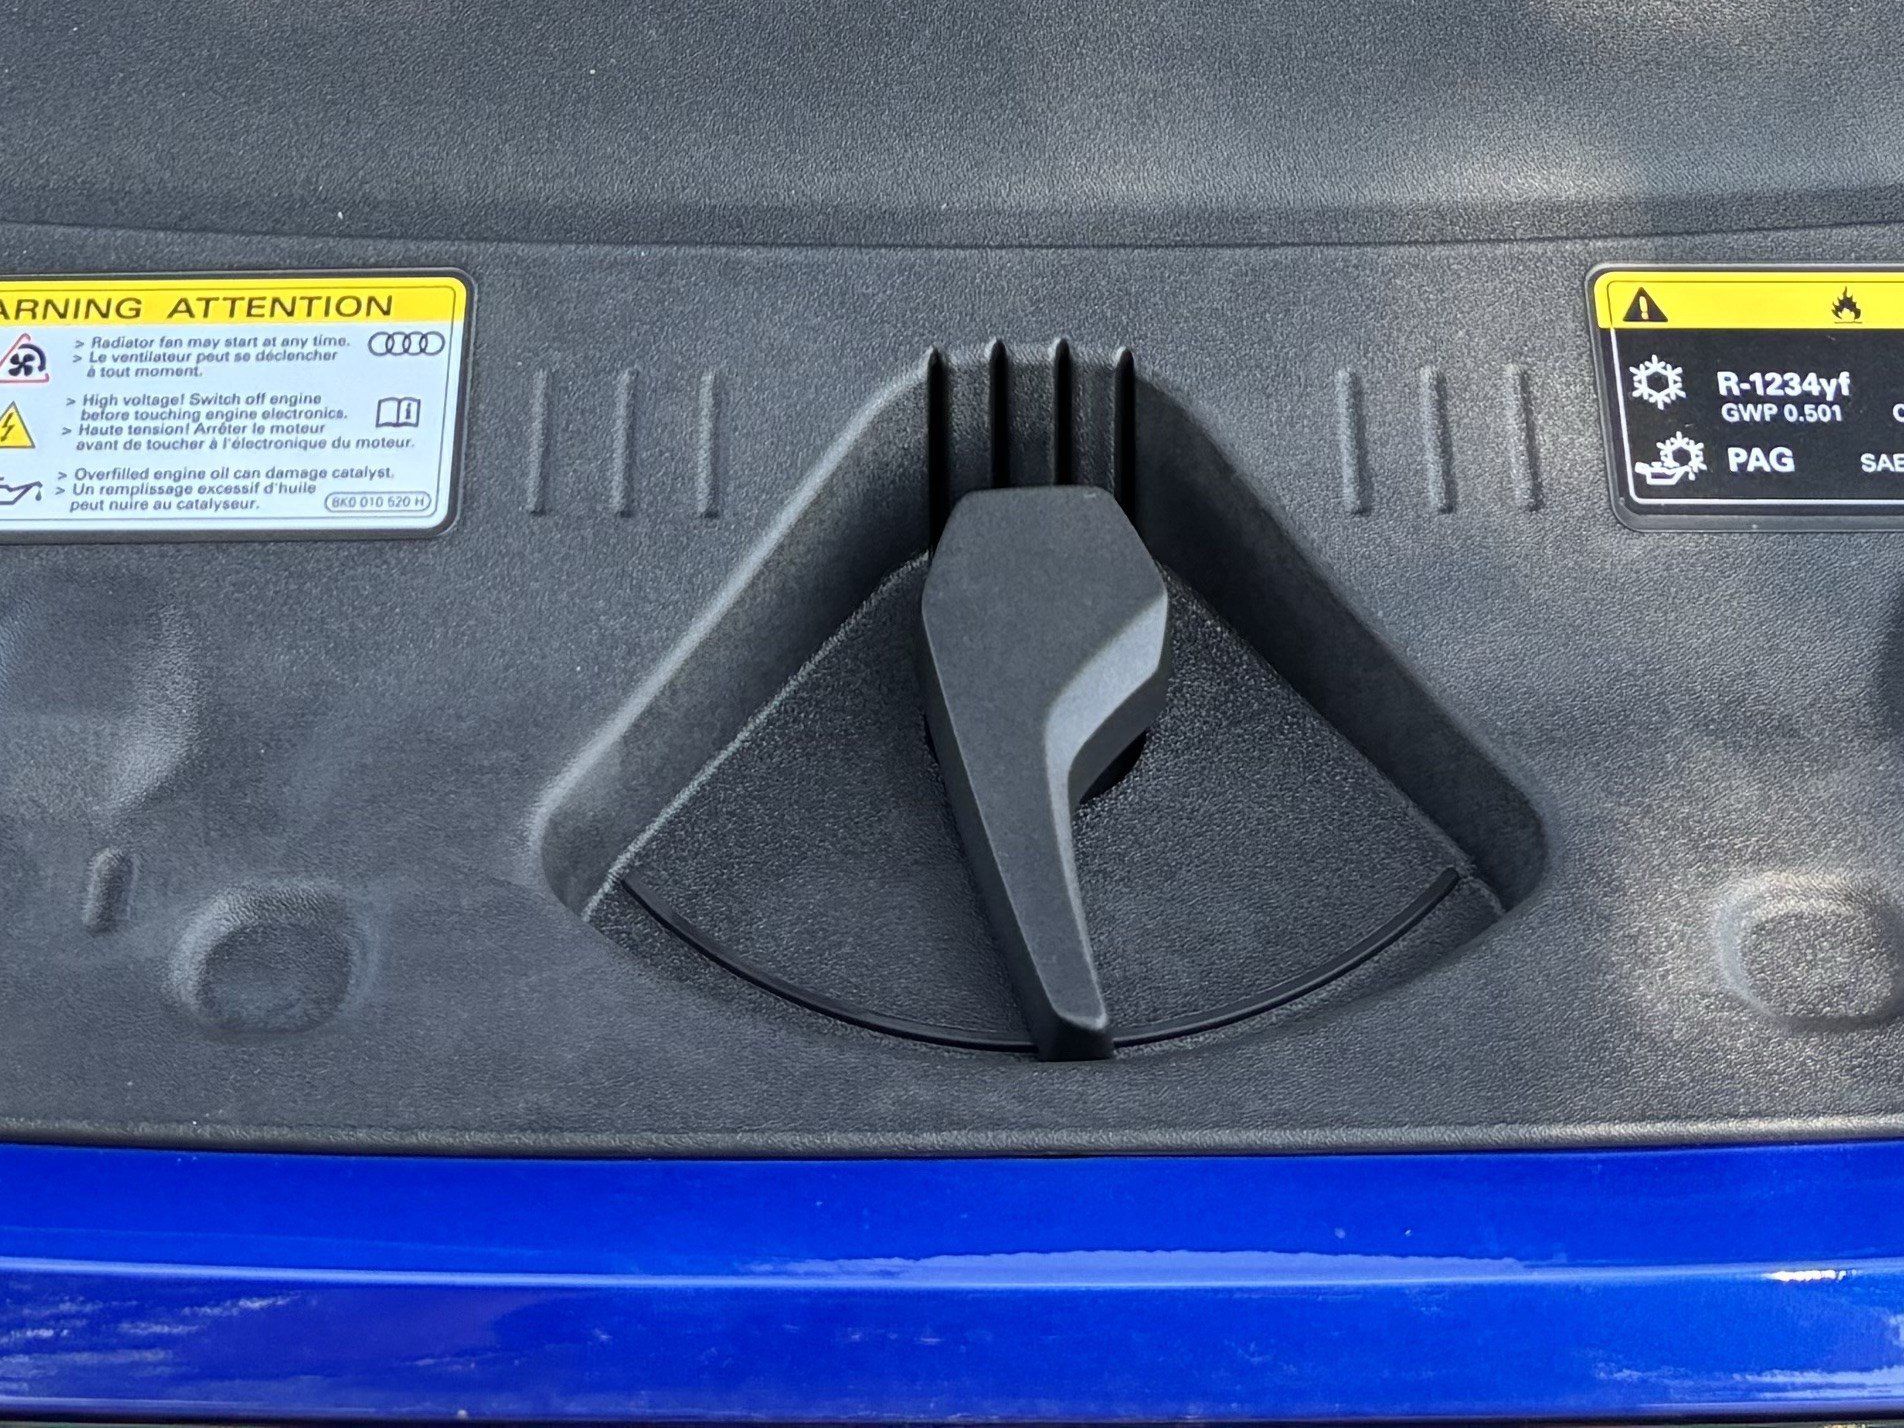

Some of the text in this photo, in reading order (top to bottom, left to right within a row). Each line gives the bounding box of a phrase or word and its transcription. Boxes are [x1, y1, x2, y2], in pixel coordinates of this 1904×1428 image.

[165, 294, 393, 319] ATTENTION
[90, 335, 155, 349] Radiator
[158, 334, 183, 349] fan
[186, 337, 221, 350] may
[223, 335, 258, 348] start
[261, 335, 277, 348] at
[279, 336, 309, 350] any
[88, 350, 107, 364] Le
[194, 350, 230, 365] peut
[233, 351, 251, 363] se
[99, 365, 131, 379] tout
[1715, 370, 1851, 400] R-1234yf
[81, 391, 322, 409] High voltage! Switch off engine
[79, 406, 130, 422] before
[133, 407, 201, 423] touching
[204, 409, 258, 423] engine
[1720, 401, 1842, 423] GWP 0.501
[77, 422, 124, 436] Haute
[126, 421, 190, 436] tension!
[251, 421, 266, 435] le
[269, 422, 326, 435] moteur
[74, 438, 119, 451] avant
[121, 437, 142, 451] de
[145, 437, 205, 451] toucher
[330, 435, 351, 449] du
[1726, 445, 1795, 473] PAG
[152, 468, 206, 483] engine
[209, 465, 230, 480] oil
[232, 468, 261, 480] can
[264, 465, 328, 482] damage
[71, 482, 95, 496] Un
[196, 480, 260, 495] excessif
[68, 498, 104, 513] peut
[107, 499, 149, 511] nuire
[151, 499, 172, 511] au
[358, 495, 384, 508] 010
